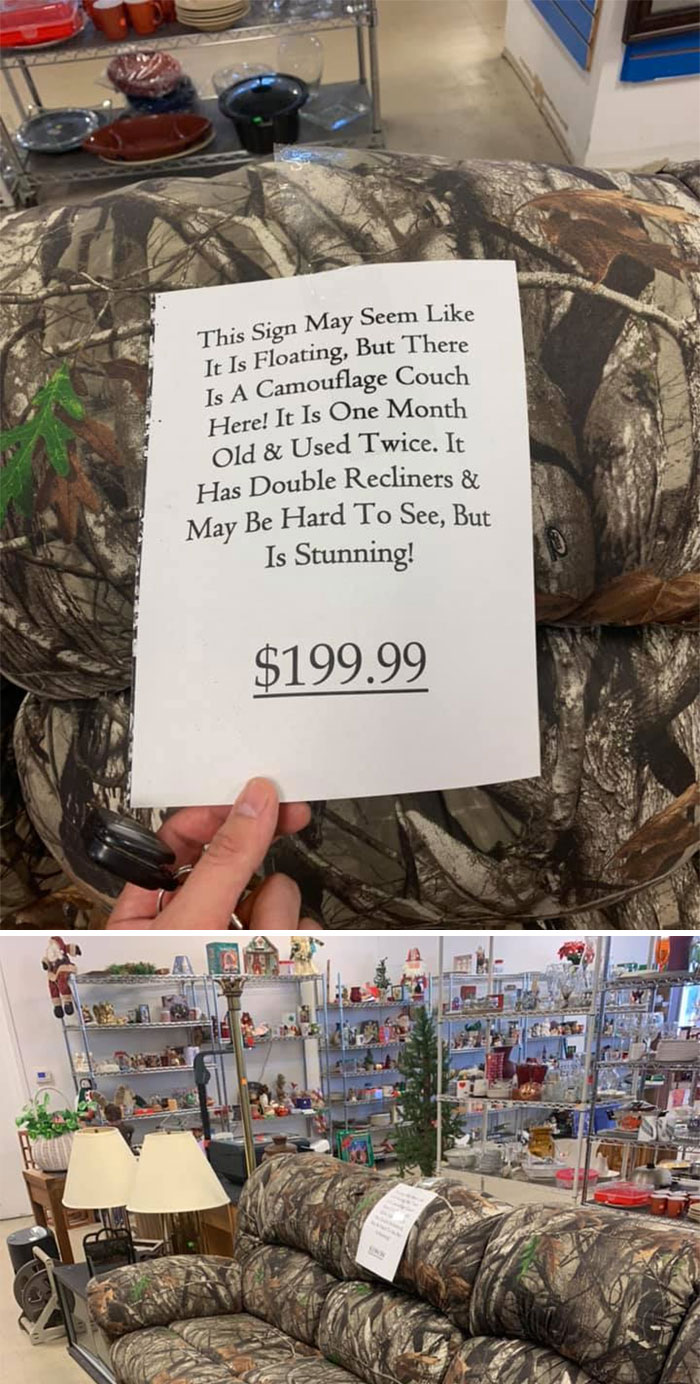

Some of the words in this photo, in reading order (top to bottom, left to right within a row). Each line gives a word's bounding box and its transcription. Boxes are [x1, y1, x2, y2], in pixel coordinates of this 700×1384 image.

[197, 328, 245, 349] This
[251, 322, 297, 344] Sign
[305, 311, 354, 335] May
[360, 307, 418, 325] Seem
[426, 303, 475, 323] Like
[204, 359, 222, 377] It
[229, 356, 247, 373] Is
[254, 344, 349, 370] Floating,
[356, 338, 395, 357] But
[401, 334, 469, 354] There
[205, 388, 224, 407] Is
[230, 384, 249, 403] A
[256, 368, 388, 398] Camouflage
[396, 365, 470, 386] Couch
[208, 411, 268, 437] Here!
[275, 408, 295, 428] It
[301, 405, 322, 424] Is
[329, 401, 379, 421] One
[386, 398, 467, 419] Month
[212, 443, 256, 468] Old
[264, 443, 283, 461] &
[291, 433, 352, 458] Used
[358, 432, 438, 454] Twice.
[445, 432, 466, 454] It
[197, 481, 242, 505] Has
[249, 467, 337, 498] Double
[344, 465, 454, 489] Recliners
[461, 469, 480, 490] &
[186, 517, 238, 545] May
[245, 511, 273, 533] Be
[281, 502, 346, 529] Hard
[353, 502, 392, 525] To
[400, 502, 446, 529] See,
[452, 504, 492, 527] But
[265, 545, 287, 569] Is
[295, 541, 414, 573] Stunning!
[254, 642, 427, 694] $199.99
